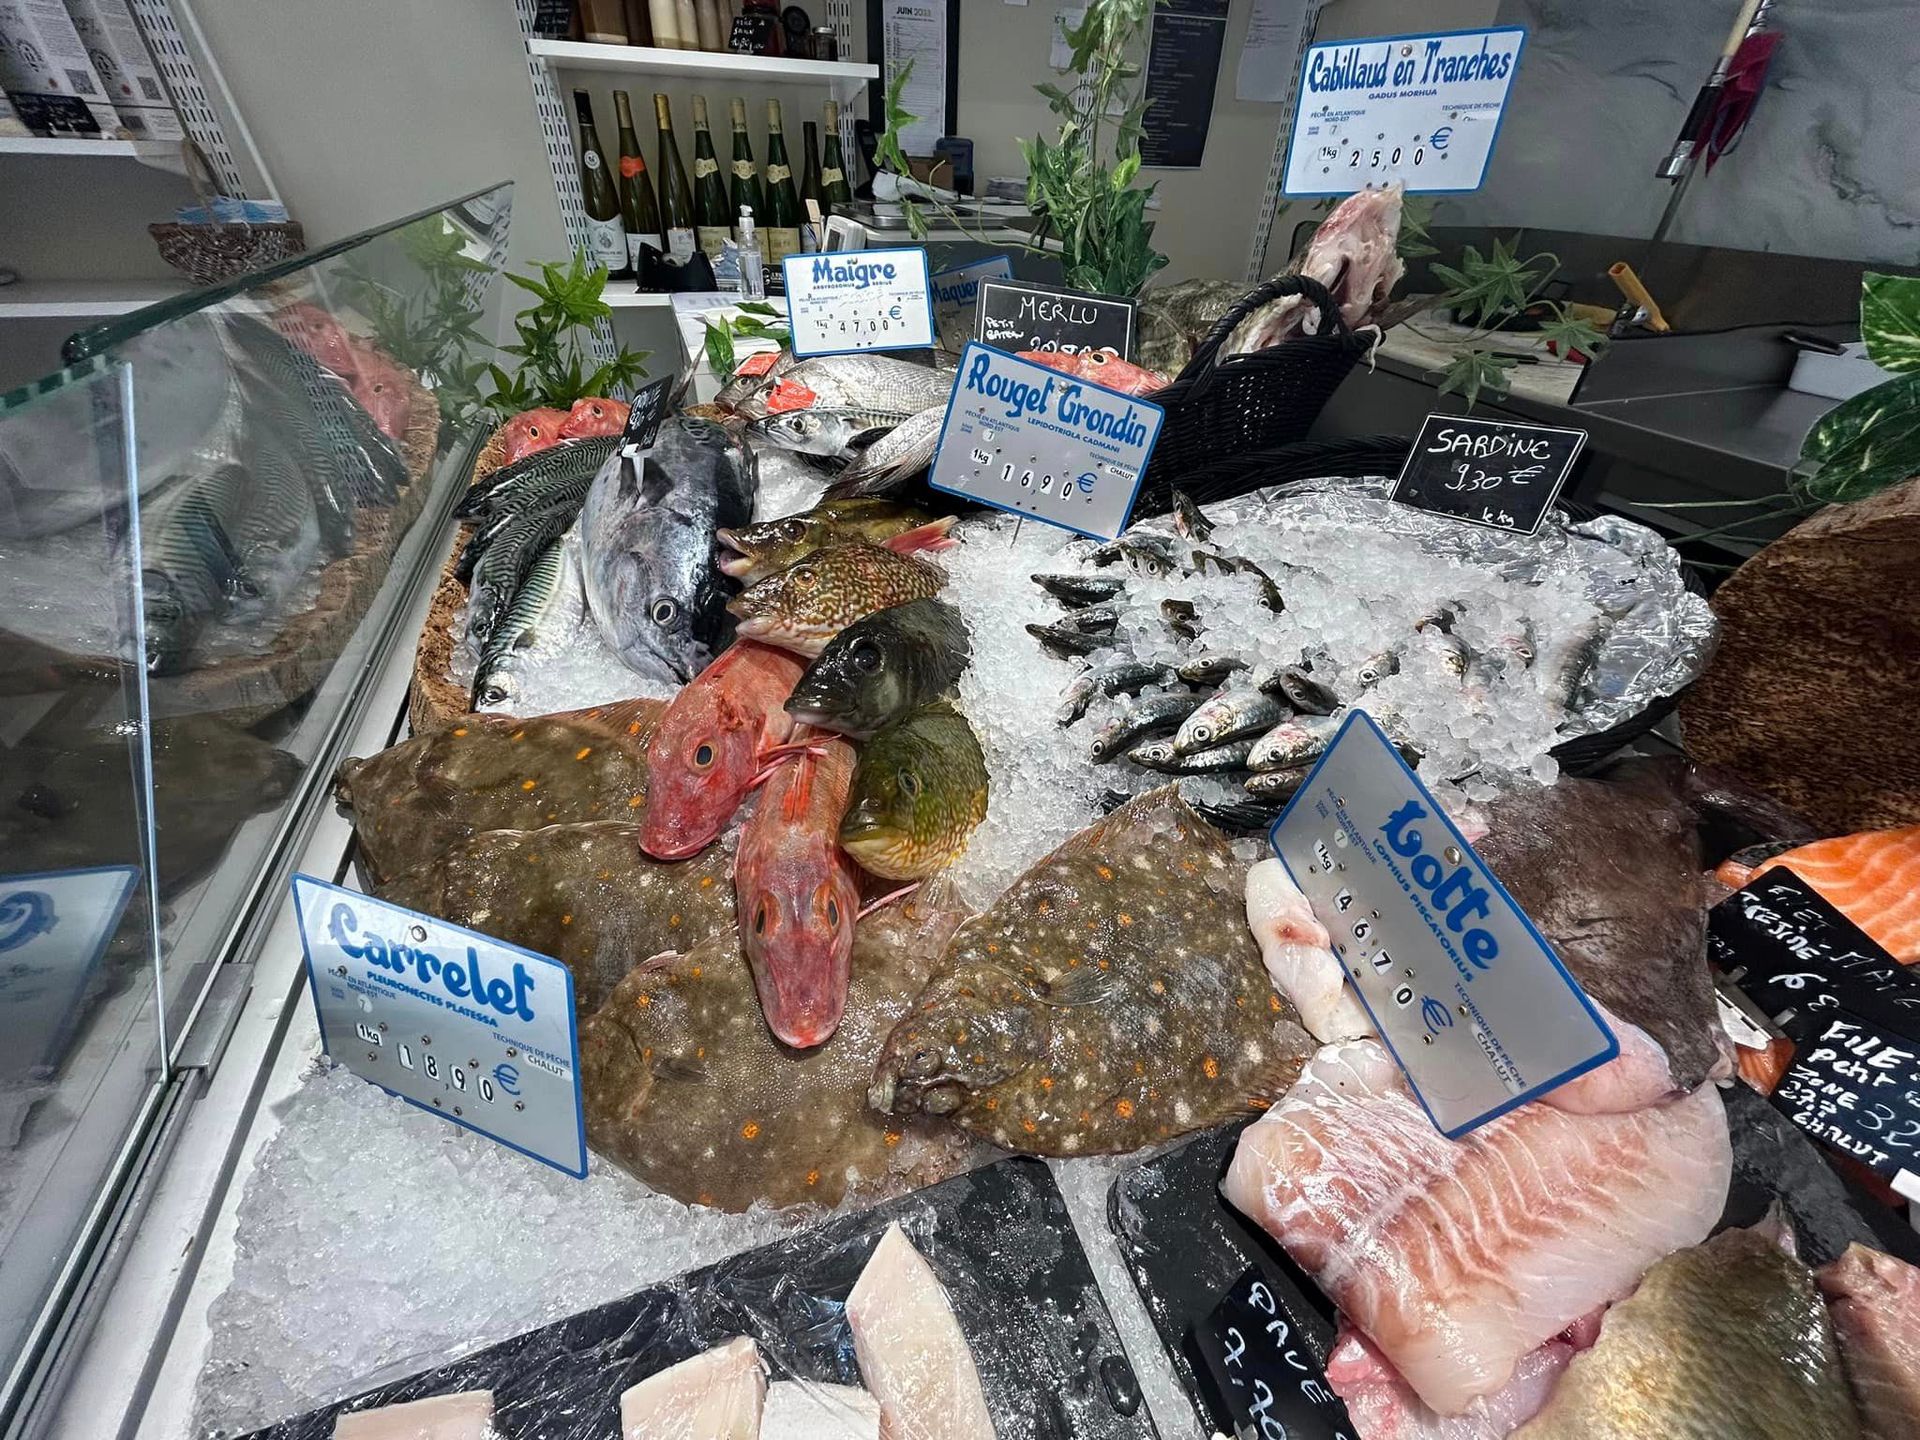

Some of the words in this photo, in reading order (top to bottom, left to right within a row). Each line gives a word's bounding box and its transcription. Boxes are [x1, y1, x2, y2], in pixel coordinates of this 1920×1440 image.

[897, 7, 913, 15] JUIN
[1309, 44, 1392, 92] Cabillaud
[1393, 57, 1416, 85] en
[1420, 35, 1511, 84] Tranches
[1369, 91, 1398, 100] GADUS
[1399, 89, 1437, 98] MORHUA
[1322, 147, 1337, 159] 1kg
[1019, 296, 1098, 325] MERLU
[966, 354, 1055, 418] Rouget
[1057, 384, 1148, 448] Grondin
[974, 448, 989, 464] 1kg
[1110, 467, 1134, 480] CHALUT
[1318, 844, 1332, 871] 1kg
[1378, 800, 1500, 970] Lotte
[1372, 838, 1412, 892] LOPHIUS
[1409, 893, 1475, 982] PISCATORIUS
[328, 902, 535, 1023] Carrelet
[367, 971, 443, 1006] PLEURONECTES
[445, 1001, 498, 1028] PLATESSA
[1454, 982, 1494, 1038] TECHNIQUE
[360, 1024, 379, 1045] 1kg
[492, 1032, 534, 1053] TECHNIQUE
[527, 1054, 564, 1076] CHALUT
[1477, 1032, 1513, 1083] CHALUT
